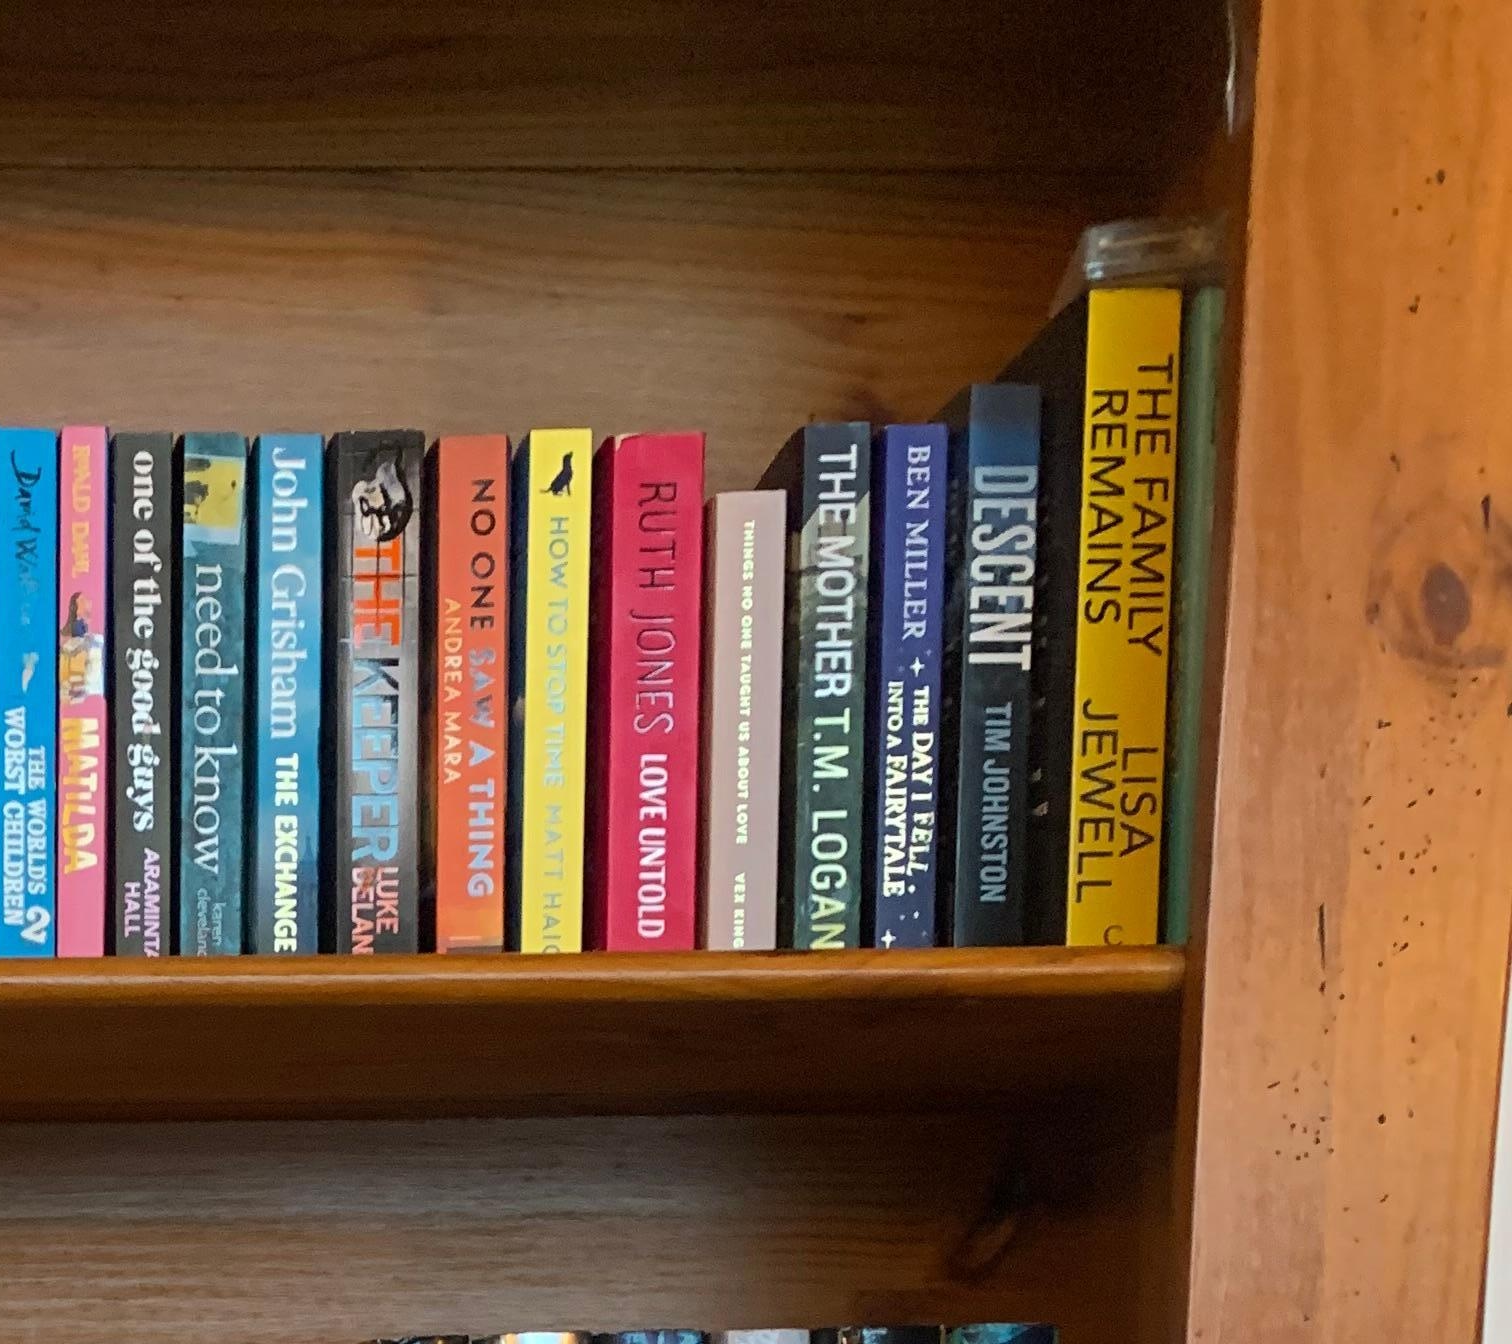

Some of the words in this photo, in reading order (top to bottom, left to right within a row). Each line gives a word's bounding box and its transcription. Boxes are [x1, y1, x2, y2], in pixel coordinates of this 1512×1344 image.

[1135, 354, 1174, 457] THE
[270, 446, 306, 552] John
[639, 481, 677, 590] RUTH
[817, 445, 857, 523] THE
[1085, 388, 1128, 625] REMAINS
[815, 534, 855, 697] MOTHER
[968, 464, 1037, 670] DESCENT
[1127, 477, 1167, 656] FAMILY
[270, 564, 306, 739] Grisham
[630, 609, 675, 735] JONES
[274, 753, 298, 806] THE
[639, 753, 669, 819] LOVE
[812, 708, 851, 792] T.M.
[984, 703, 1013, 752] TIM
[979, 759, 1011, 902] JOHNSTON
[1076, 698, 1116, 903] JEWELL
[1119, 746, 1158, 858] LISA
[273, 815, 298, 953] EXCHANGE
[637, 827, 666, 938] UNTOLD
[811, 810, 848, 950] LOGAN
